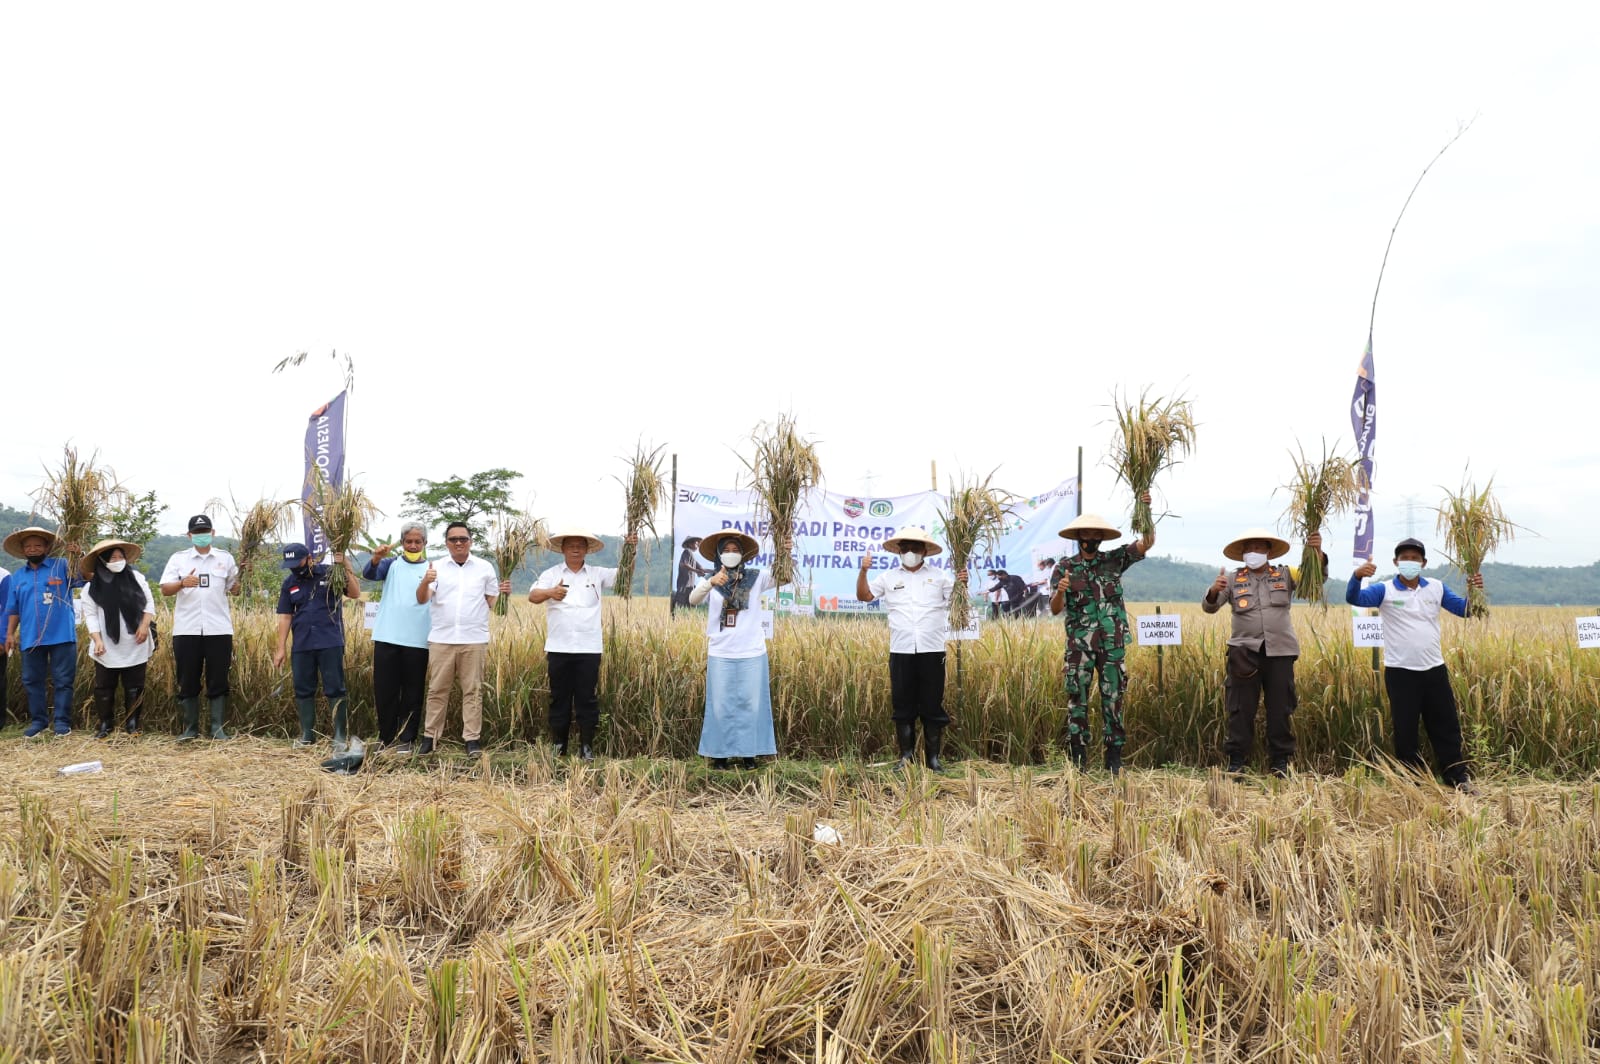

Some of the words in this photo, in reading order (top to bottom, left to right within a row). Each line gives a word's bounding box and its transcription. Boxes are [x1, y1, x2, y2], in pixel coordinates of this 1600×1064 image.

[802, 554, 853, 569] MITRA
[1140, 621, 1178, 629] DANRAMIL
[1145, 630, 1174, 638] LAKBOK
